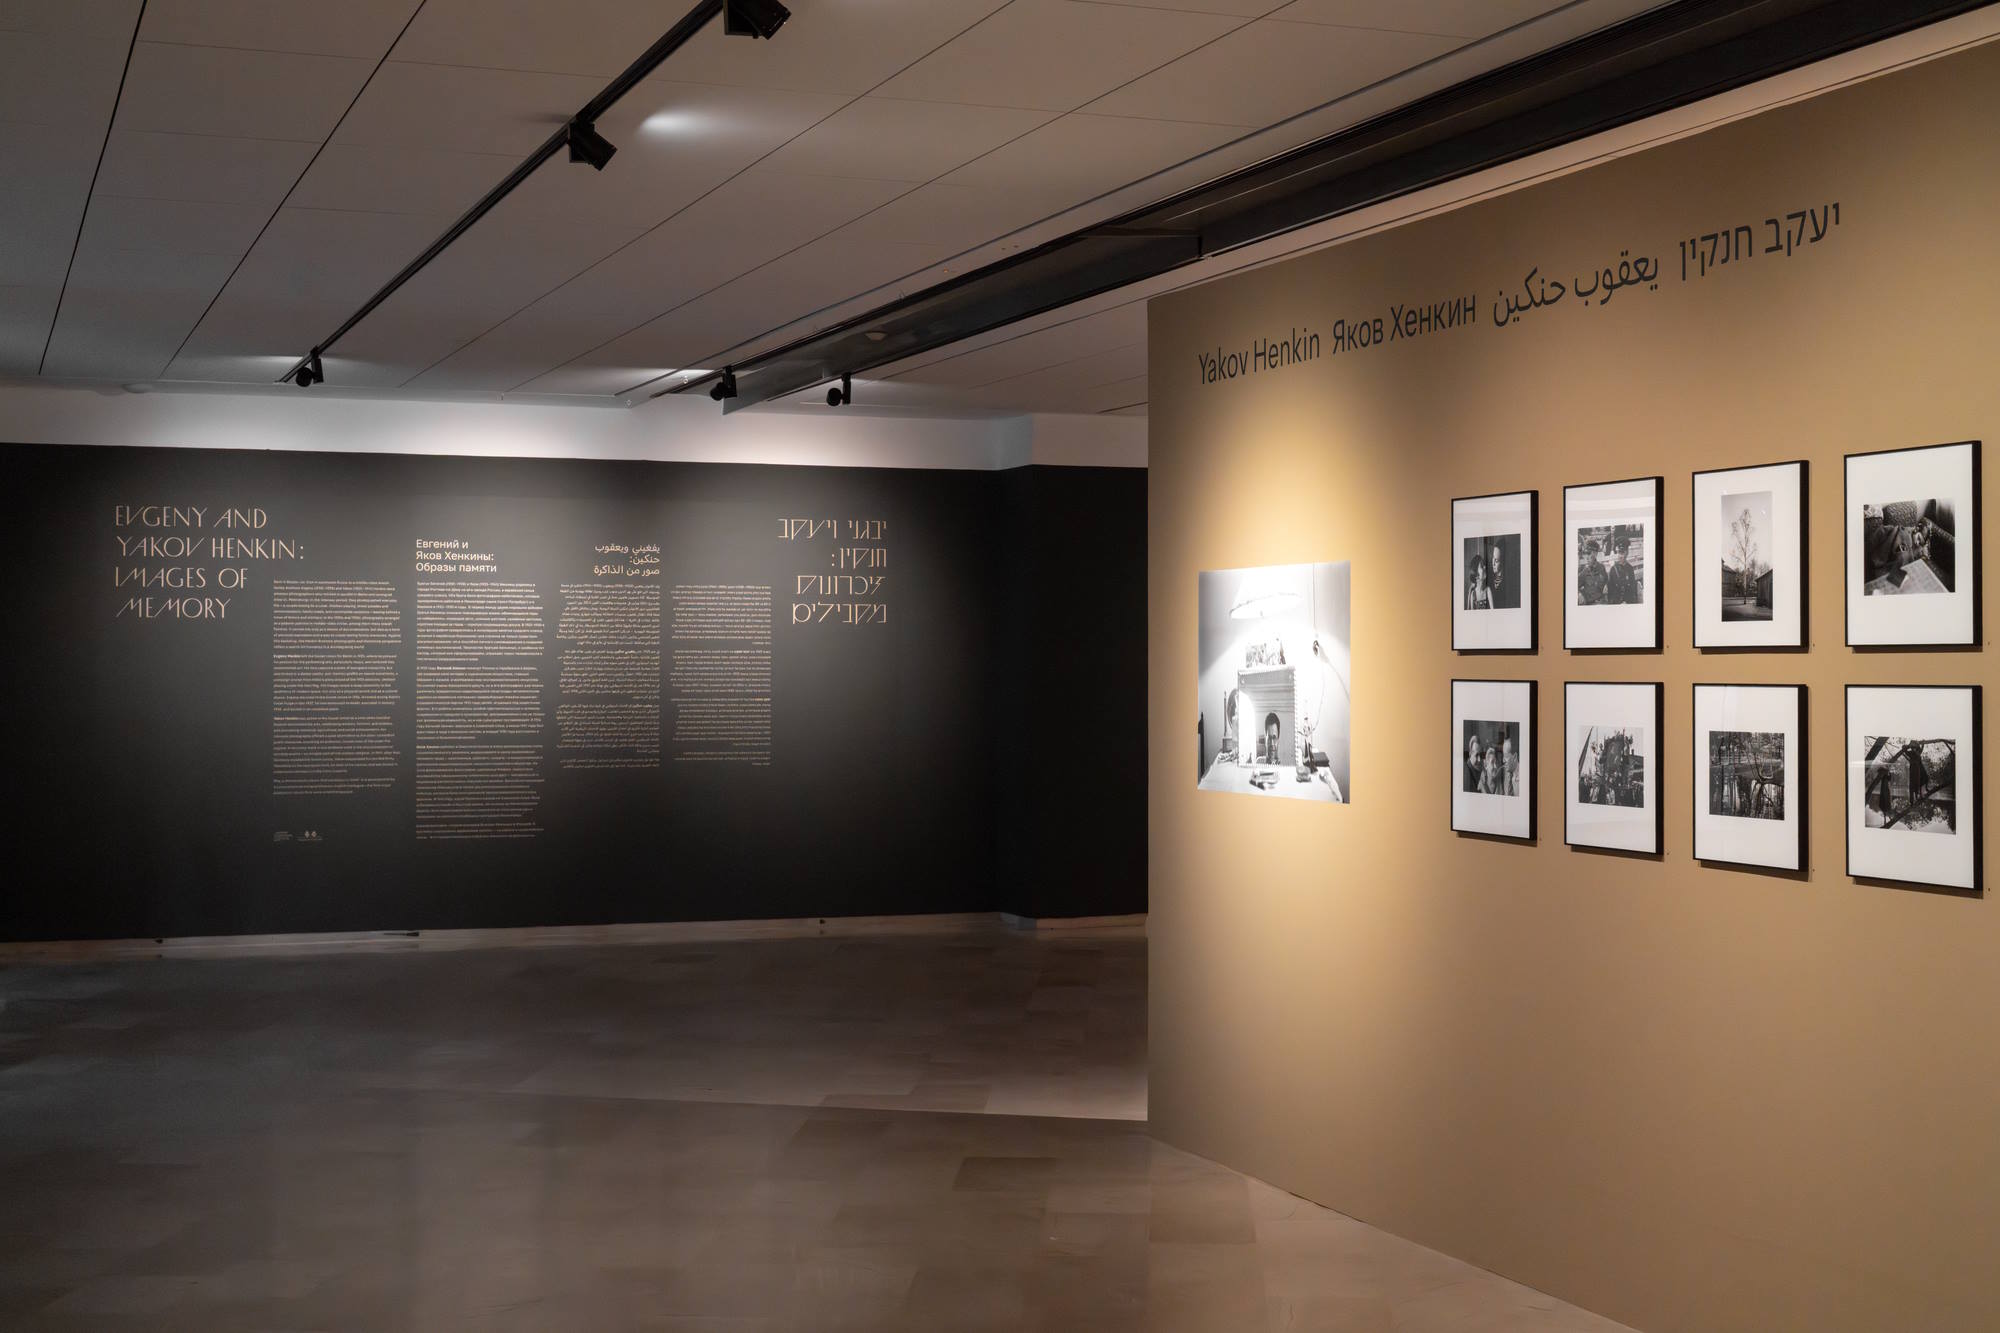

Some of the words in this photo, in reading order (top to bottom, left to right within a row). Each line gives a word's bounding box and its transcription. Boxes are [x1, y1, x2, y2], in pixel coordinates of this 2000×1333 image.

[1764, 201, 1840, 257] יעקב
[1679, 225, 1753, 282] חנקין
[1574, 249, 1659, 307] يعقوب
[1493, 266, 1567, 328] حنكين
[1332, 318, 1384, 355] Яков
[1389, 294, 1476, 342] Хенкин
[1198, 346, 1249, 386] Yakov
[1253, 327, 1320, 373] Henkin
[115, 505, 208, 528] EVGENY
[213, 508, 267, 529] AND
[777, 518, 838, 541] ויעקב
[848, 520, 887, 540] יבגני
[116, 535, 205, 558] YAKOV
[212, 537, 304, 560] HENKIN:
[416, 538, 460, 550] Евгений
[462, 541, 469, 550] и
[416, 550, 442, 560] Яков
[444, 551, 495, 561] Хенкины:
[595, 543, 630, 554] ويعقوب
[415, 562, 457, 574] Образы
[459, 564, 497, 573] памяти
[831, 547, 887, 570] חנקין:
[115, 566, 206, 589] IMAGES
[218, 567, 249, 590] OF
[593, 564, 624, 577] الذاكرة
[626, 567, 641, 577] من
[641, 567, 660, 577] صور
[115, 597, 232, 619] MEMORY
[792, 601, 887, 625] מקבילים
